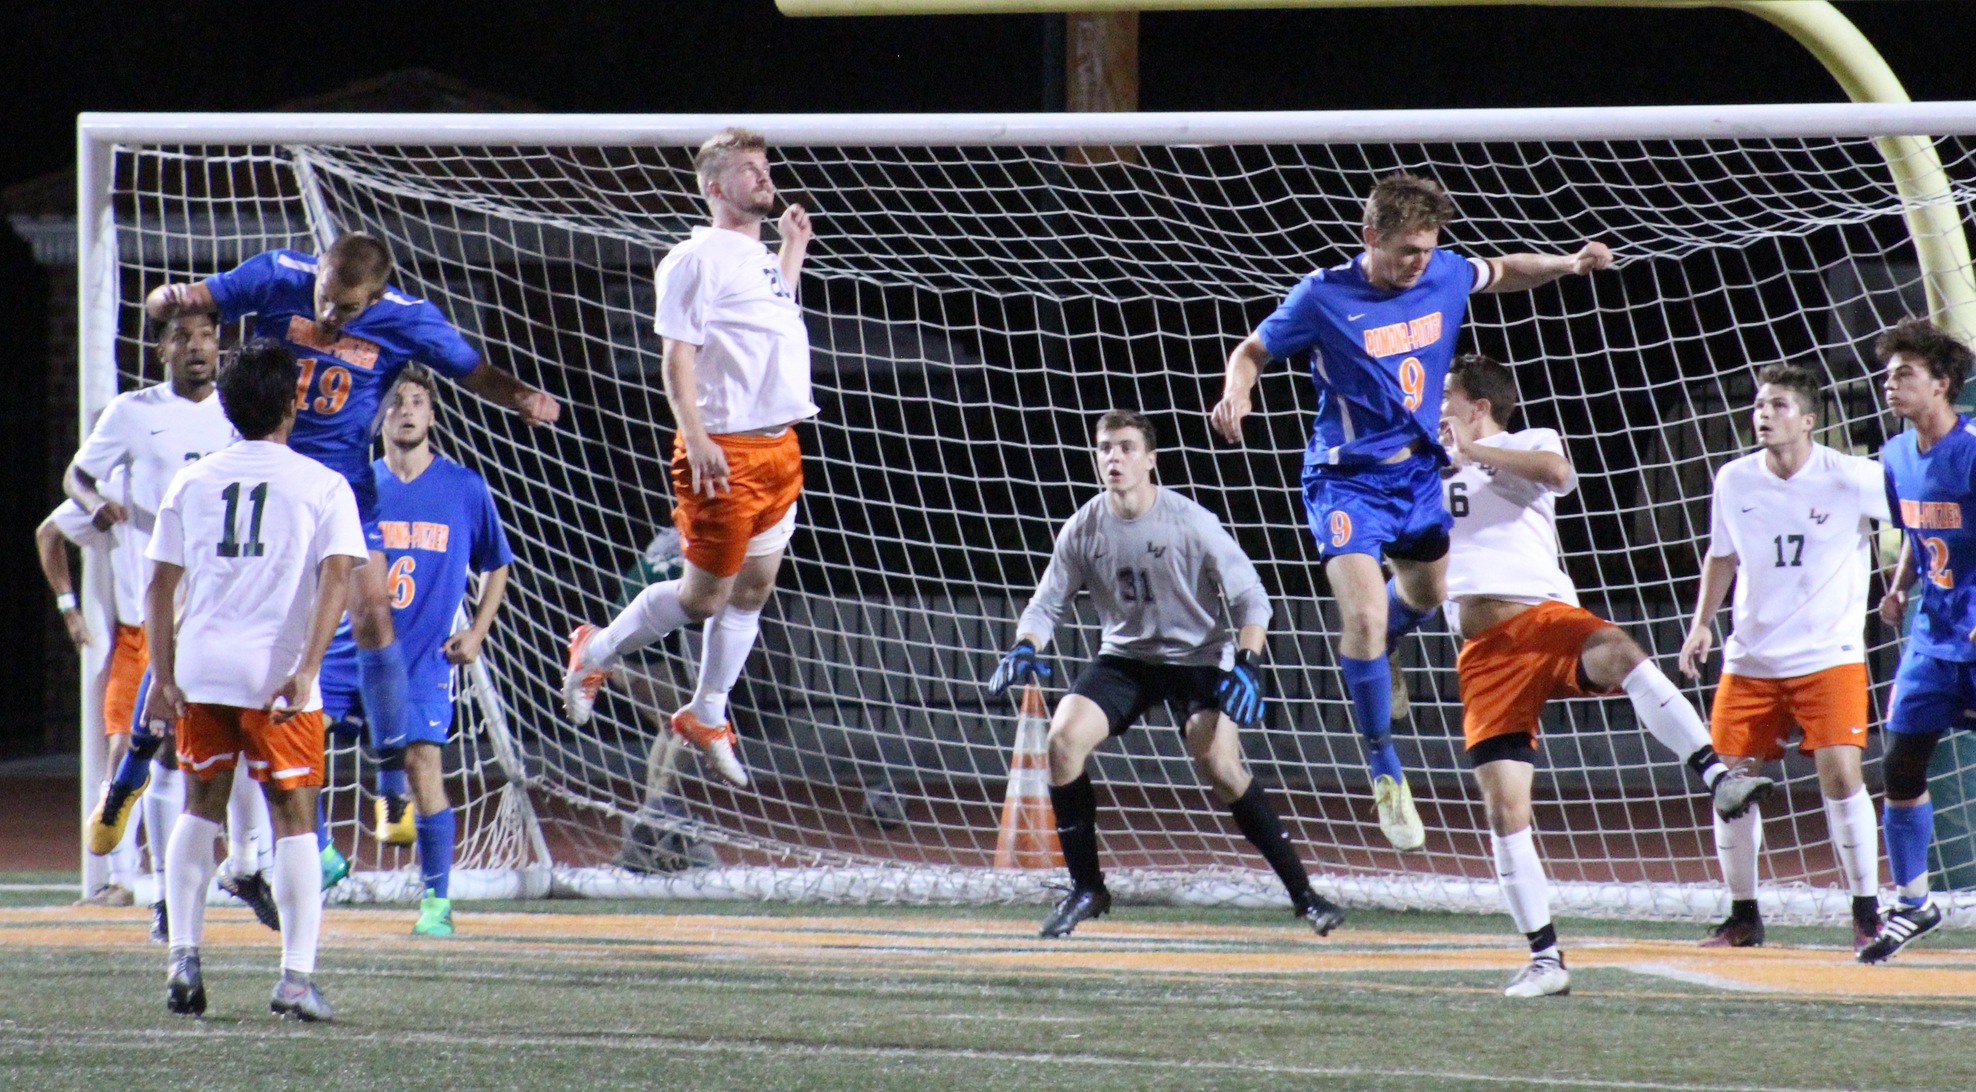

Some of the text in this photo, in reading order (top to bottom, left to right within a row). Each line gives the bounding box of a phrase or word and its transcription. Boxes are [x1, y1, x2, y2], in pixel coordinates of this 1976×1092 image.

[295, 357, 352, 415] 19
[1399, 356, 1426, 413] 9
[216, 481, 268, 557] 11
[1330, 510, 1353, 547] 9
[1809, 507, 1831, 526] LV
[1773, 534, 1805, 568] 17
[387, 555, 416, 610] 6
[1116, 567, 1156, 605] 31
